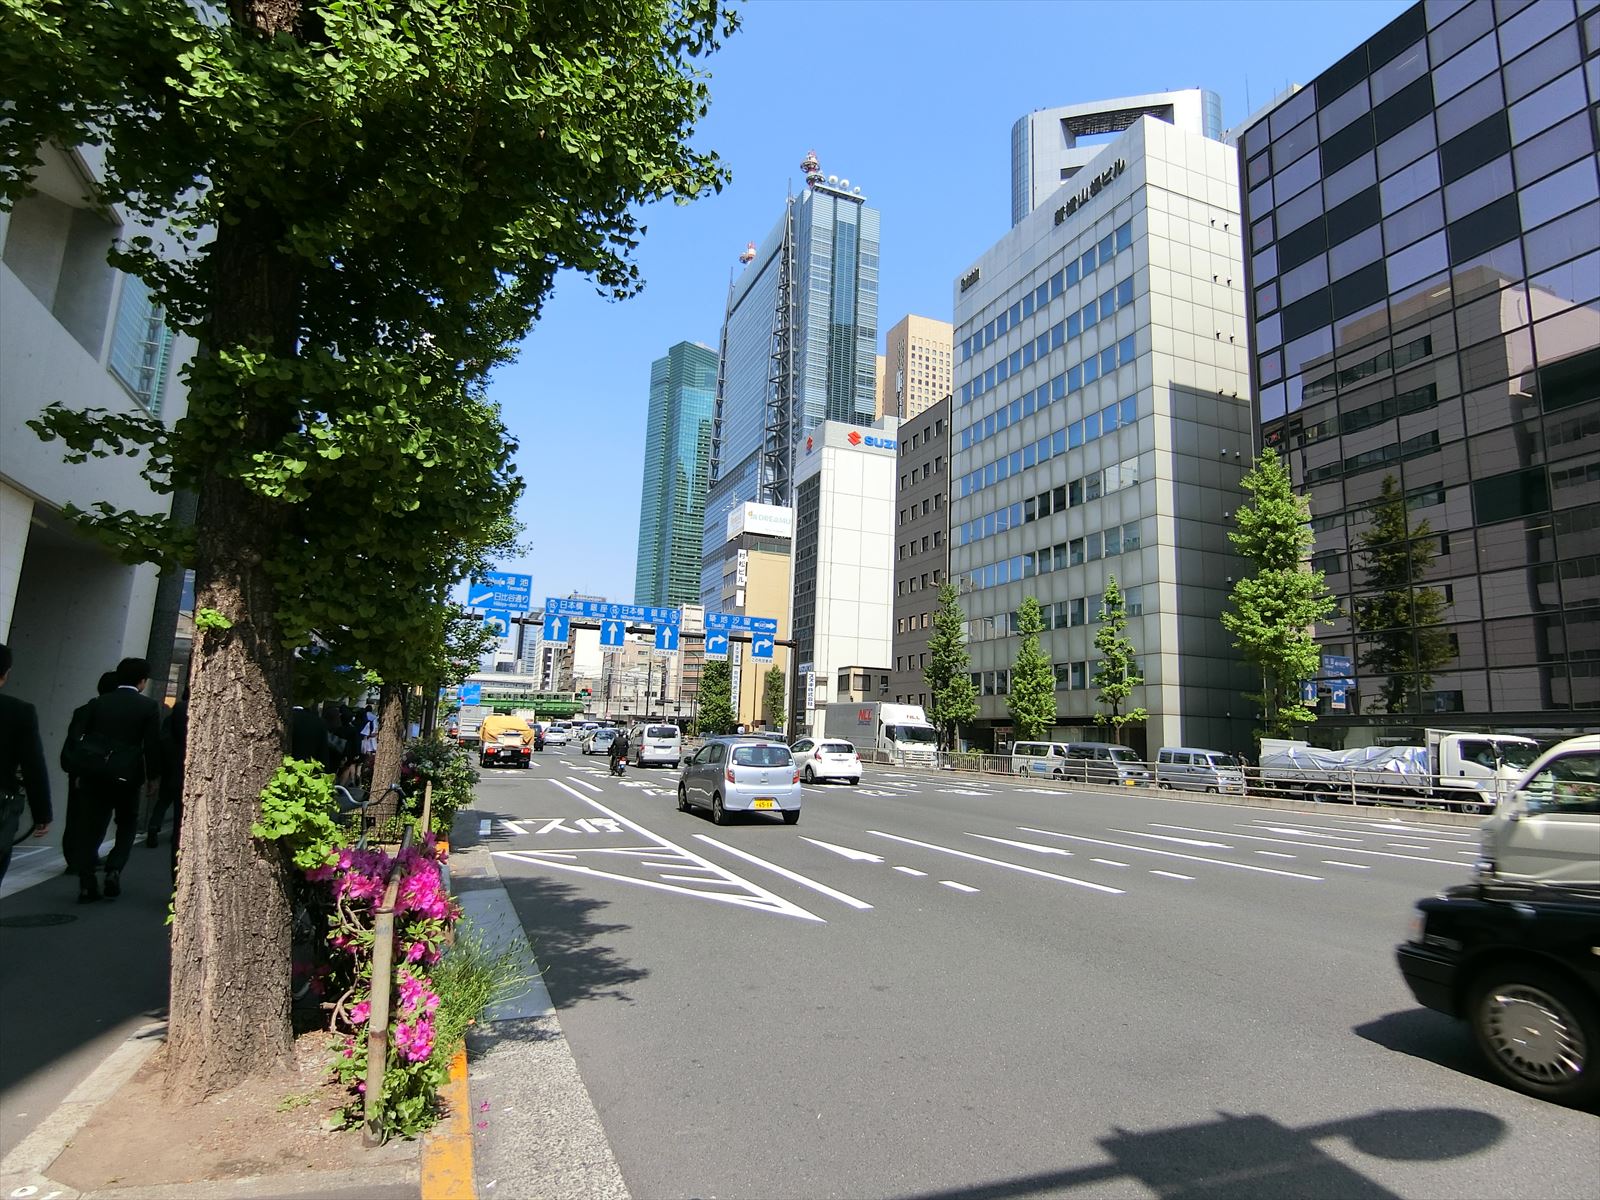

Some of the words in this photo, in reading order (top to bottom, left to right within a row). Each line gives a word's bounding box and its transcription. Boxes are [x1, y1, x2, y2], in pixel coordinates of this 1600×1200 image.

[494, 592, 529, 604] 日比谷通り
[560, 600, 584, 610] 日本橋
[622, 606, 645, 616] 日本橋
[709, 614, 729, 624] 築地
[732, 617, 751, 626] 汐留
